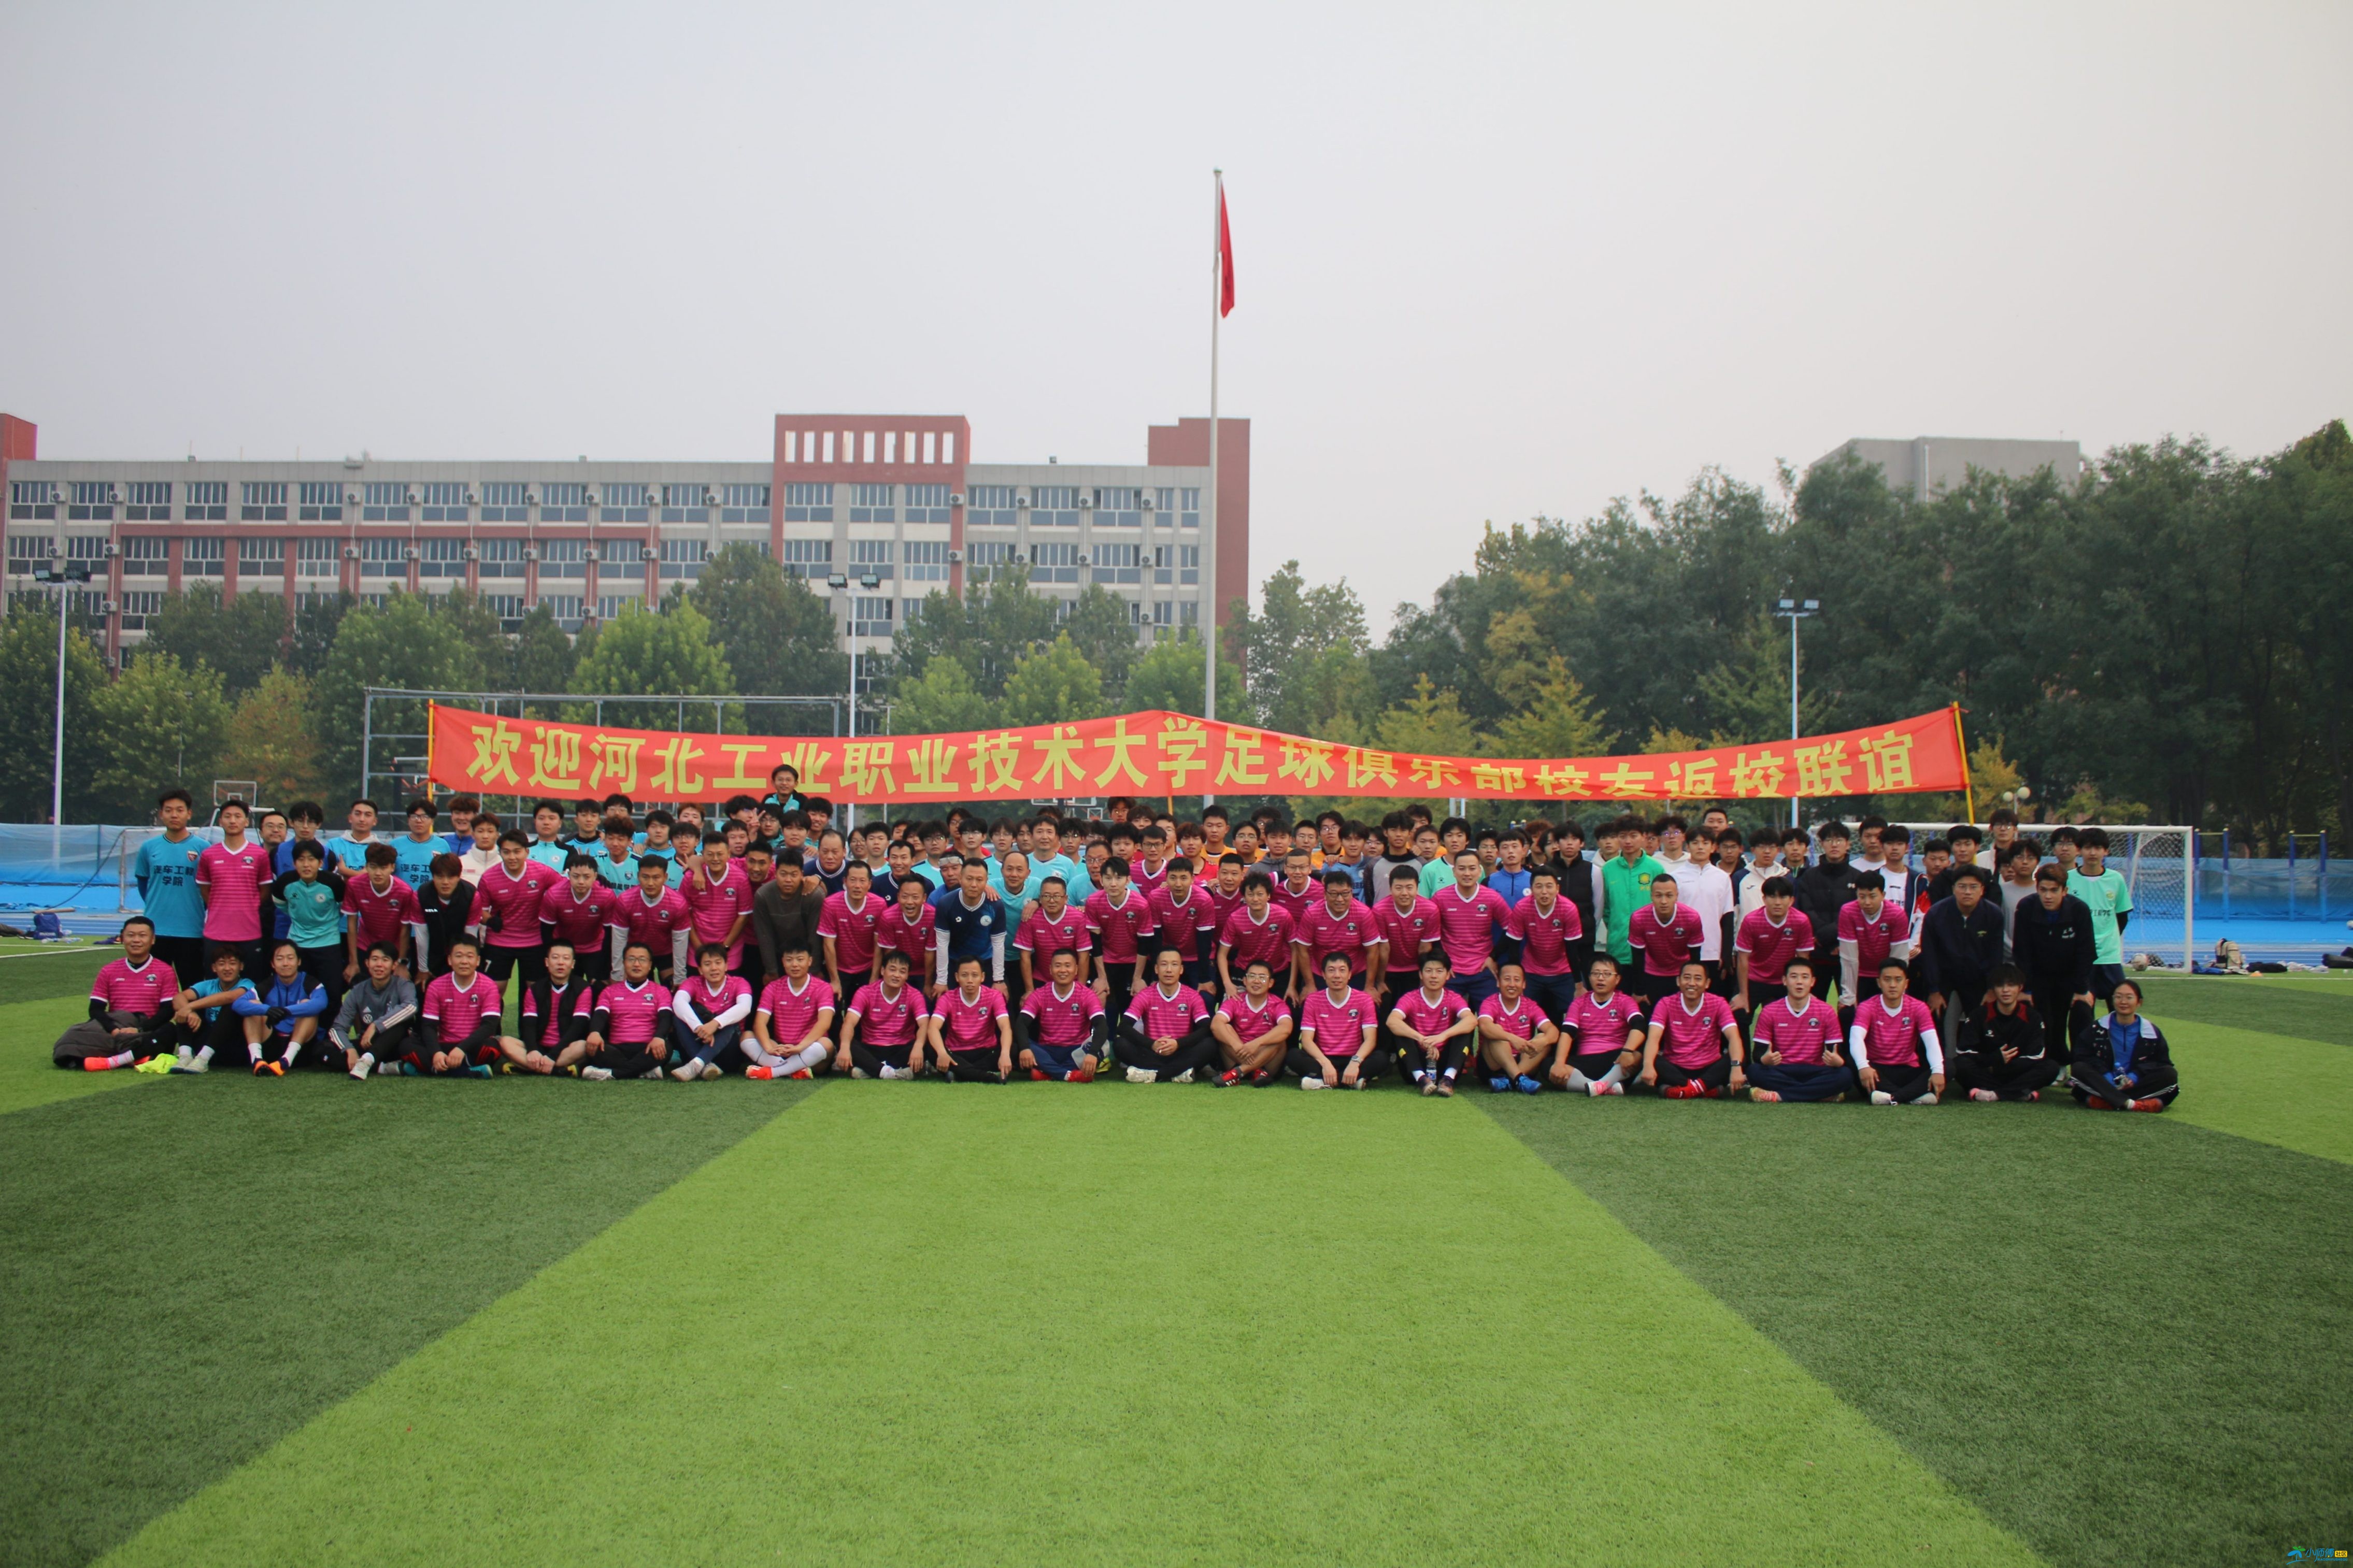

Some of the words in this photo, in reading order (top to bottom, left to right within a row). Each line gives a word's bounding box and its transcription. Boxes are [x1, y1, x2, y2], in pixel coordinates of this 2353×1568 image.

[466, 717, 1919, 798] 欢迎河北工业职业技术大学足球俱乐部校友返校联谊
